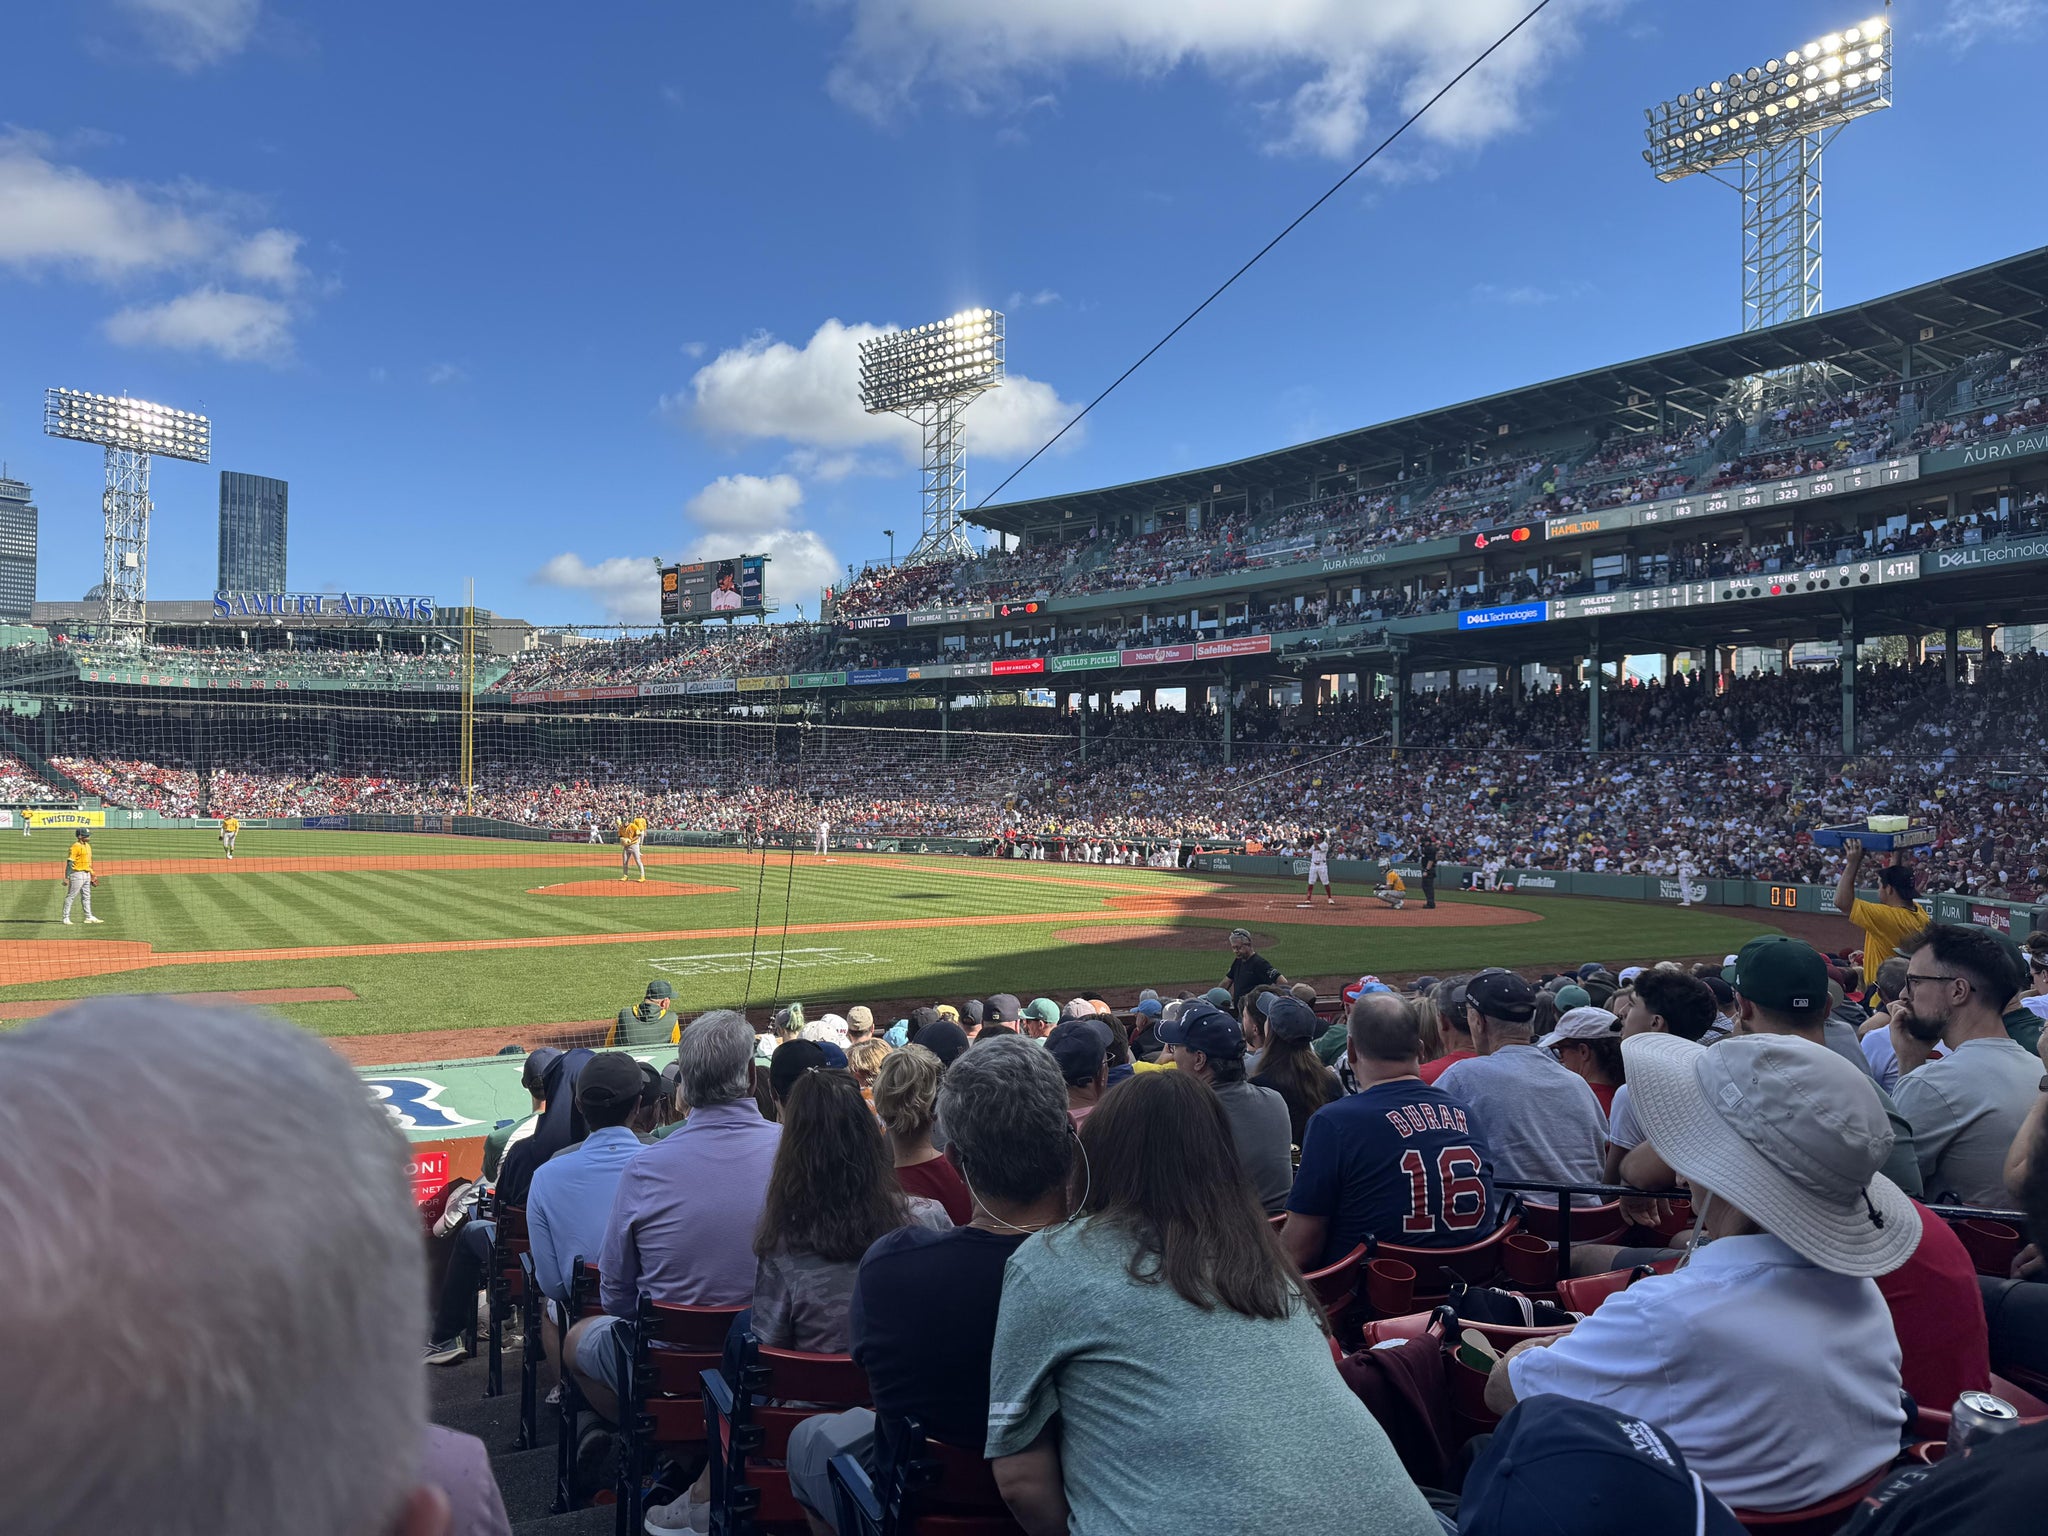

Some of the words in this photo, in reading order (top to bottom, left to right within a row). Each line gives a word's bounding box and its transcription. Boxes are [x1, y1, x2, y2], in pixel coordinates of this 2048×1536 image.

[1852, 467, 1862, 475] HR
[1889, 470, 1899, 480] 17
[1780, 481, 1793, 489] SLG
[1854, 477, 1861, 487] 5
[1811, 482, 1833, 495] .590
[1741, 495, 1760, 506] .261
[1775, 489, 1799, 501] .329
[1675, 506, 1691, 516] 183
[1706, 500, 1728, 512] .204
[1645, 511, 1658, 521] 86
[1551, 520, 1600, 537] HAMILTON
[1490, 533, 1510, 543] prefers
[1349, 552, 1386, 567] PAVILION
[1939, 550, 1981, 568] DELL
[1809, 570, 1827, 579] OUT
[1887, 561, 1914, 577] 4TH
[1730, 579, 1753, 589] BALL
[1767, 573, 1800, 585] STRIKE
[1555, 601, 1566, 609] 70
[1580, 596, 1616, 606] ATHLETICS
[1634, 592, 1640, 600] 4
[1652, 589, 1659, 598] 5
[1671, 587, 1678, 596] 0
[1697, 585, 1703, 593] 2
[213, 590, 325, 618] SAMUEL
[336, 591, 434, 622] ADAMS
[1584, 605, 1611, 615] BOSTON
[1634, 602, 1640, 610] 2
[1652, 600, 1659, 608] 5
[1467, 614, 1490, 625] DELL
[1489, 609, 1538, 623] Technologies
[857, 617, 891, 630] UNITED
[1135, 651, 1154, 661] Ninety
[1165, 651, 1180, 659] Nine
[1197, 644, 1232, 656] Safelite
[1062, 657, 1088, 668] GRILLO'S
[1090, 655, 1117, 665] PICKLES
[108, 673, 116, 682] 4
[207, 678, 218, 689] 14
[41, 815, 76, 825] TWISTED
[76, 815, 91, 825] TEA
[127, 811, 143, 820] 380
[1517, 873, 1556, 888] Franklin
[1385, 1103, 1469, 1139] DURAN
[1400, 1145, 1487, 1233] 16
